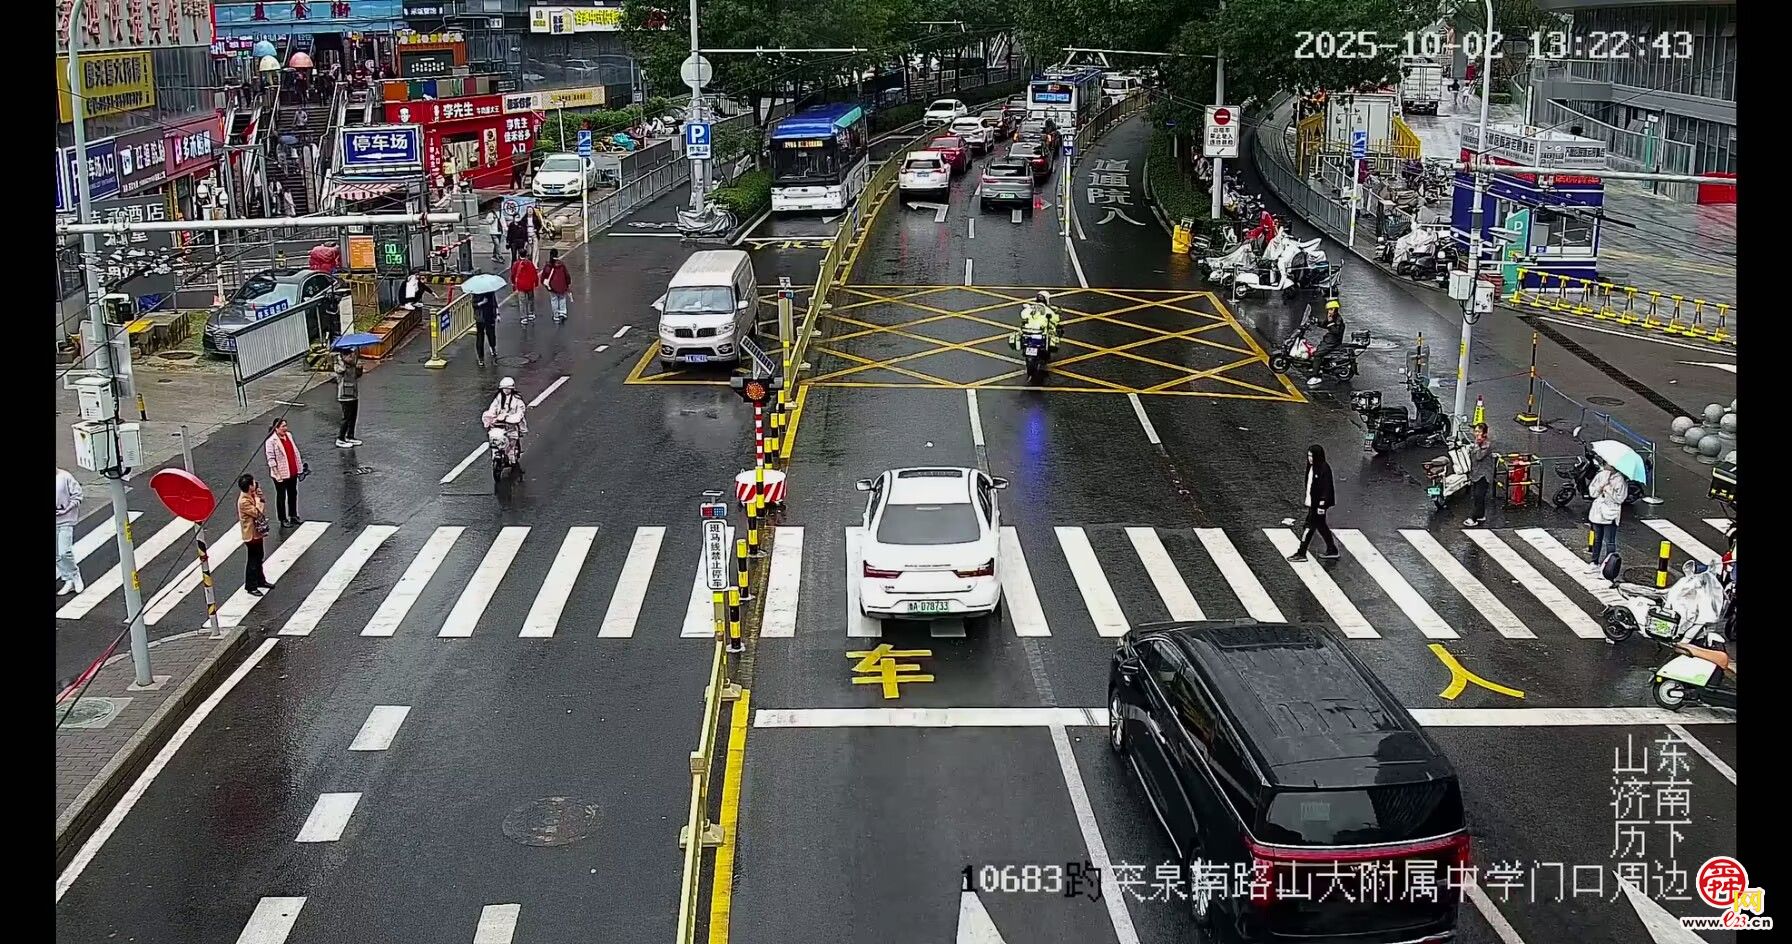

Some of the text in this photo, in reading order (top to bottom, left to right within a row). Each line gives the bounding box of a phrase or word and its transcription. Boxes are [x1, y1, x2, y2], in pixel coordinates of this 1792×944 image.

[443, 102, 474, 119] 李先生
[506, 117, 528, 130] 李先生
[352, 133, 408, 152] 停车场
[691, 125, 705, 143] P
[511, 143, 526, 154] 入口
[1515, 221, 1523, 231] P
[709, 524, 722, 588] 斑马线禁止停车
[846, 644, 1525, 700] 车 人
